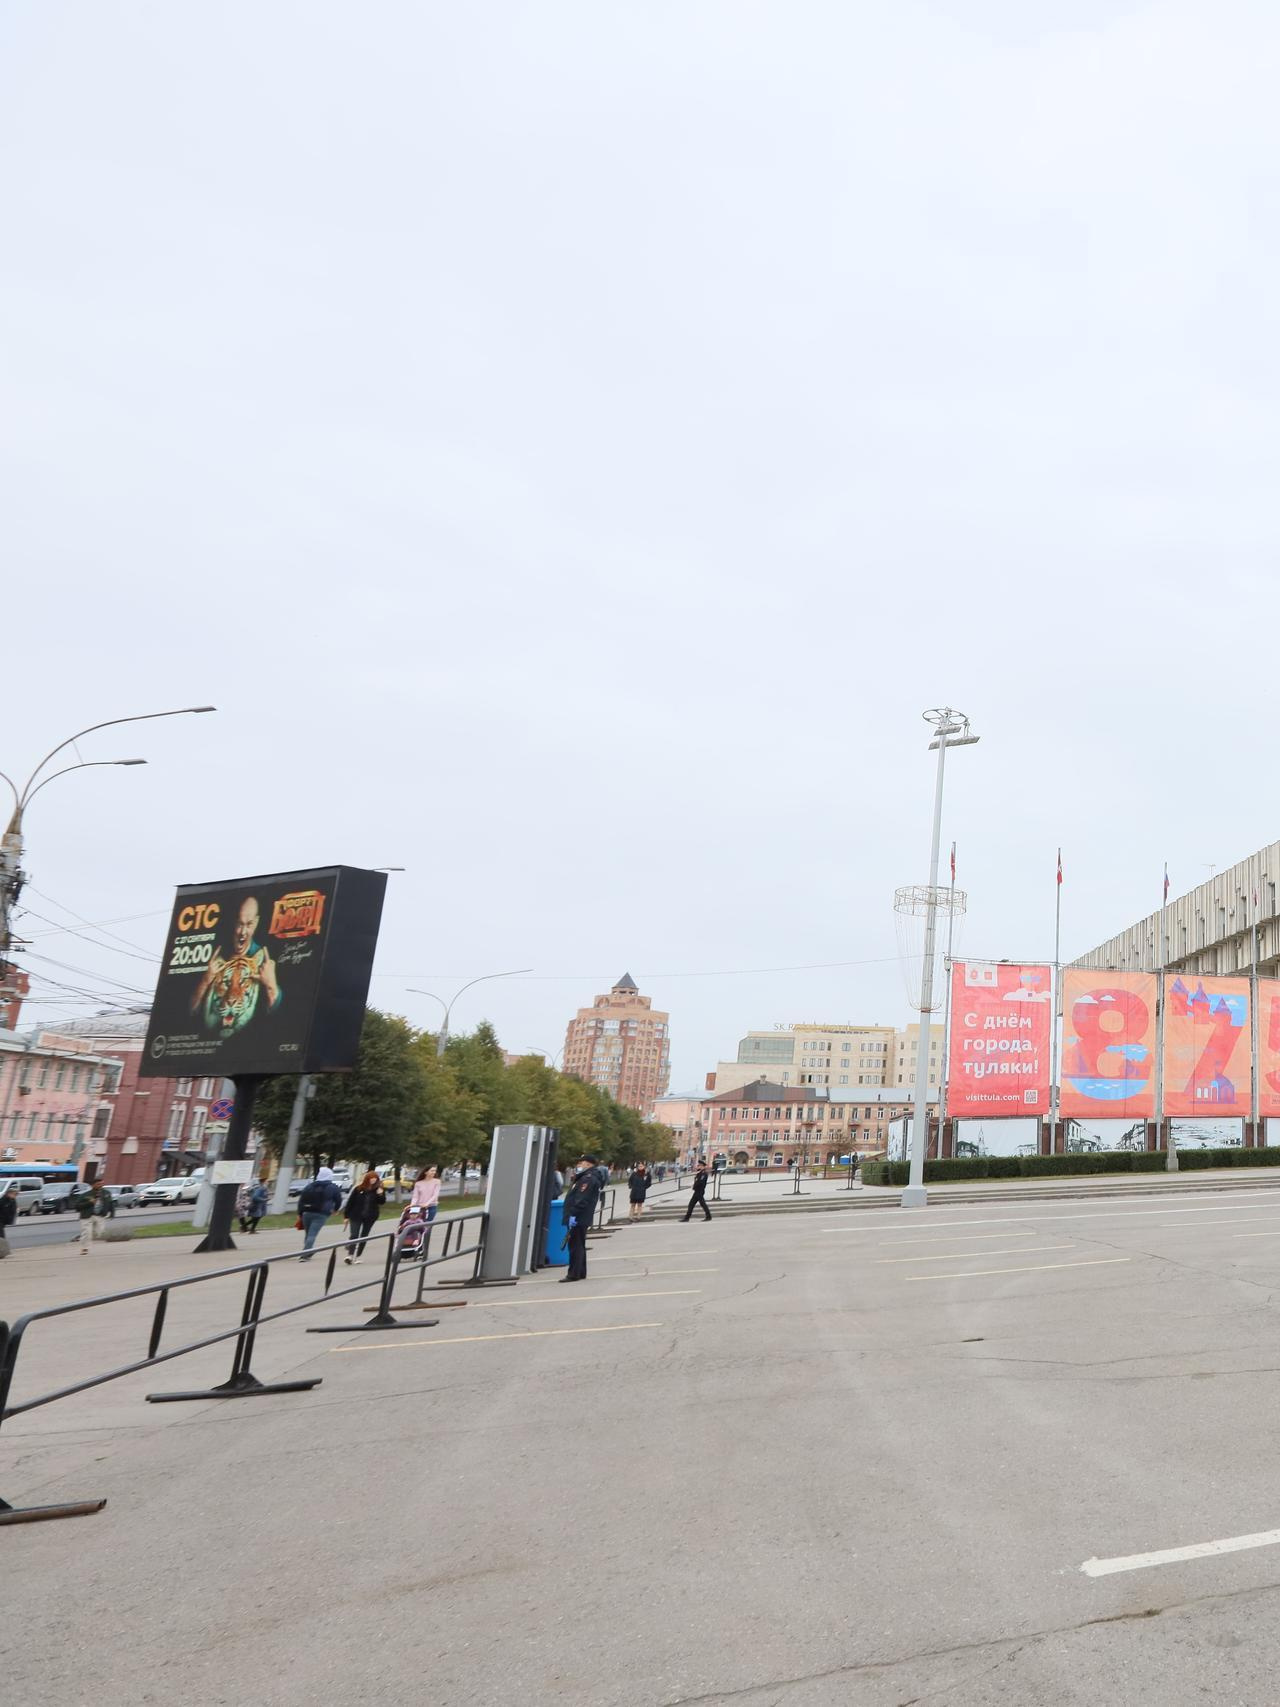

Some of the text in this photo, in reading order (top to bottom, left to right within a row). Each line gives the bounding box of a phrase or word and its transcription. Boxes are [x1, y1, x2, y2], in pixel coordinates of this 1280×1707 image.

[178, 903, 220, 931] СТС
[169, 943, 212, 966] 20:00
[964, 1012, 1032, 1030] С днём
[963, 1039, 1038, 1054] города,
[963, 1059, 1039, 1079] туляки!
[965, 1093, 1020, 1102] visittula.com
